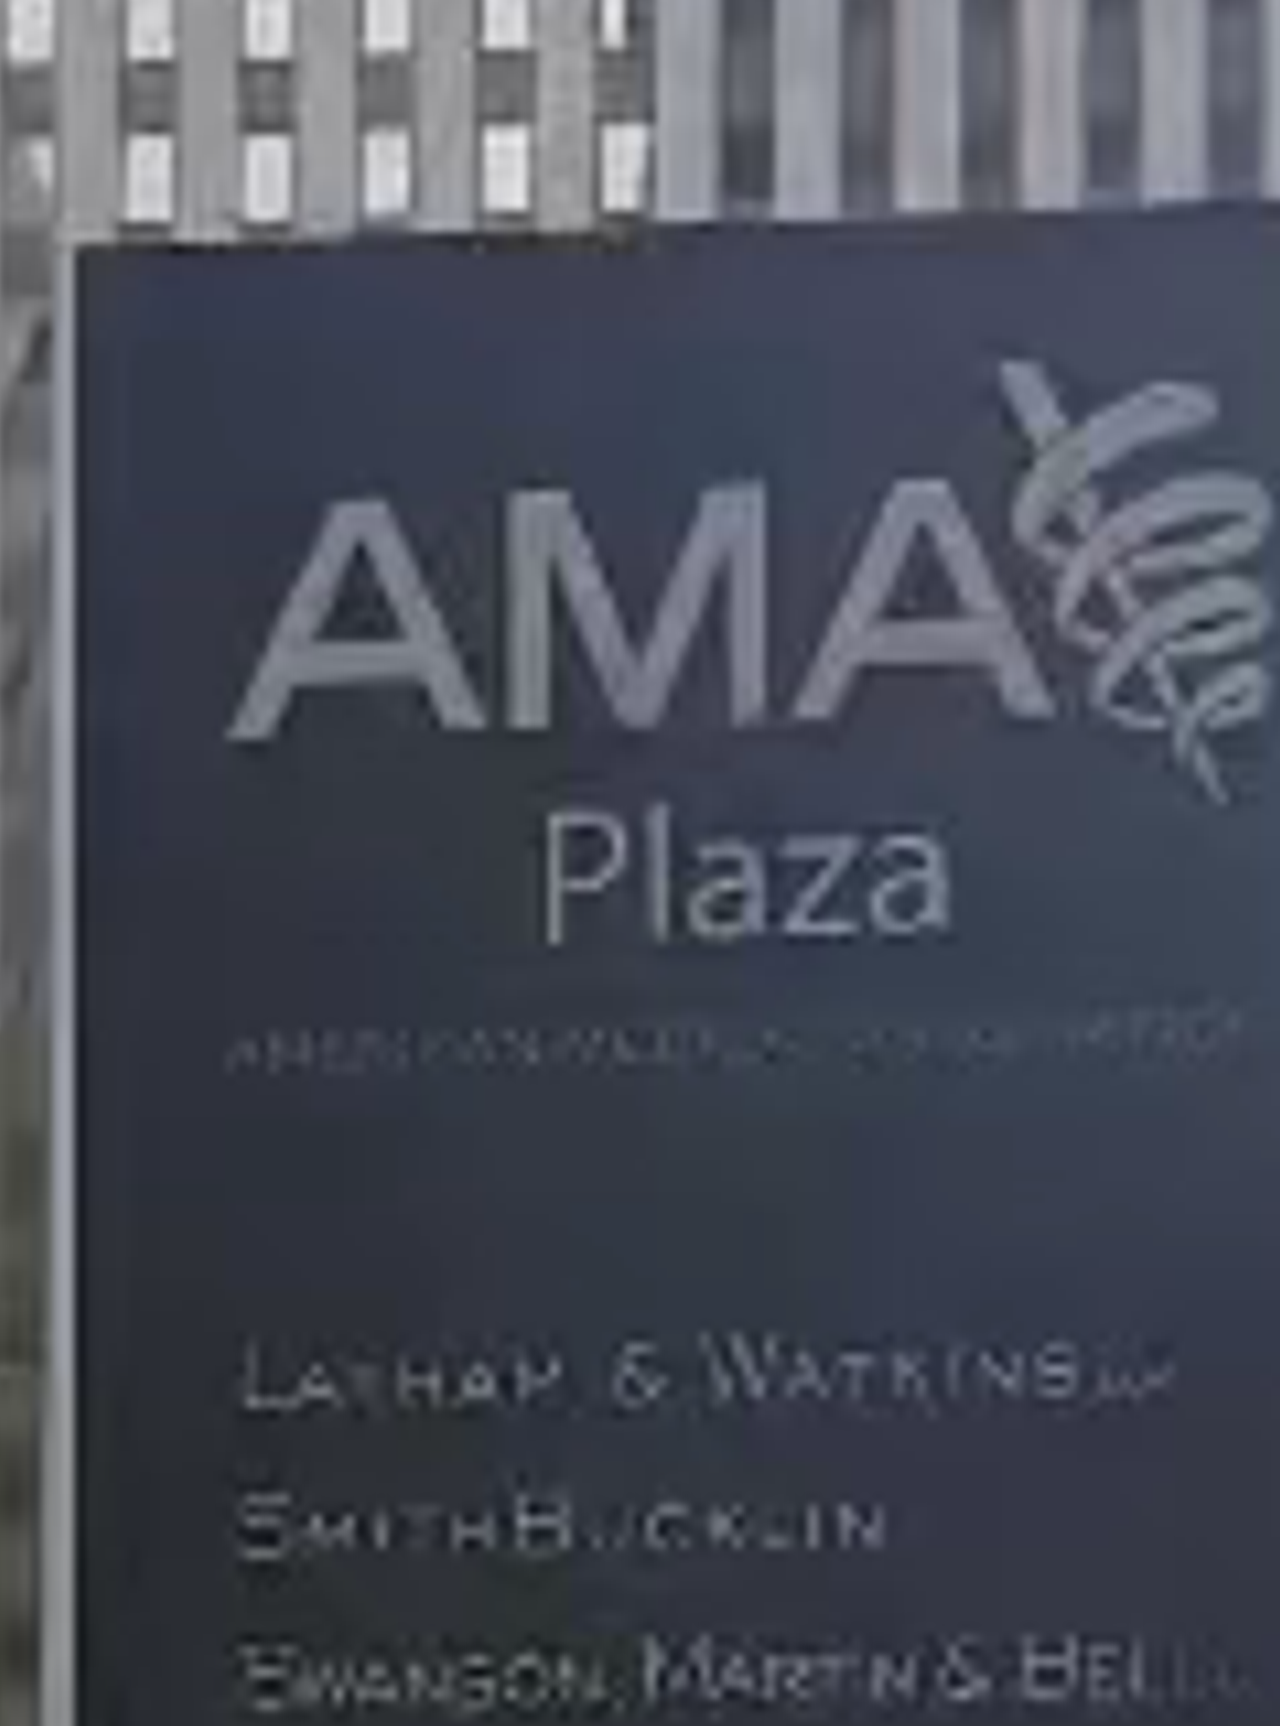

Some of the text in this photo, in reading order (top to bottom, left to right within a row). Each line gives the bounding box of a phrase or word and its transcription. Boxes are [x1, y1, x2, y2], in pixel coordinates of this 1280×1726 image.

[226, 477, 1056, 741] AMA
[541, 801, 953, 947] Plaza
[241, 1343, 565, 1412] LATHAM
[610, 1340, 671, 1410] &
[697, 1329, 1082, 1406] WATKINS
[934, 1642, 994, 1704] &
